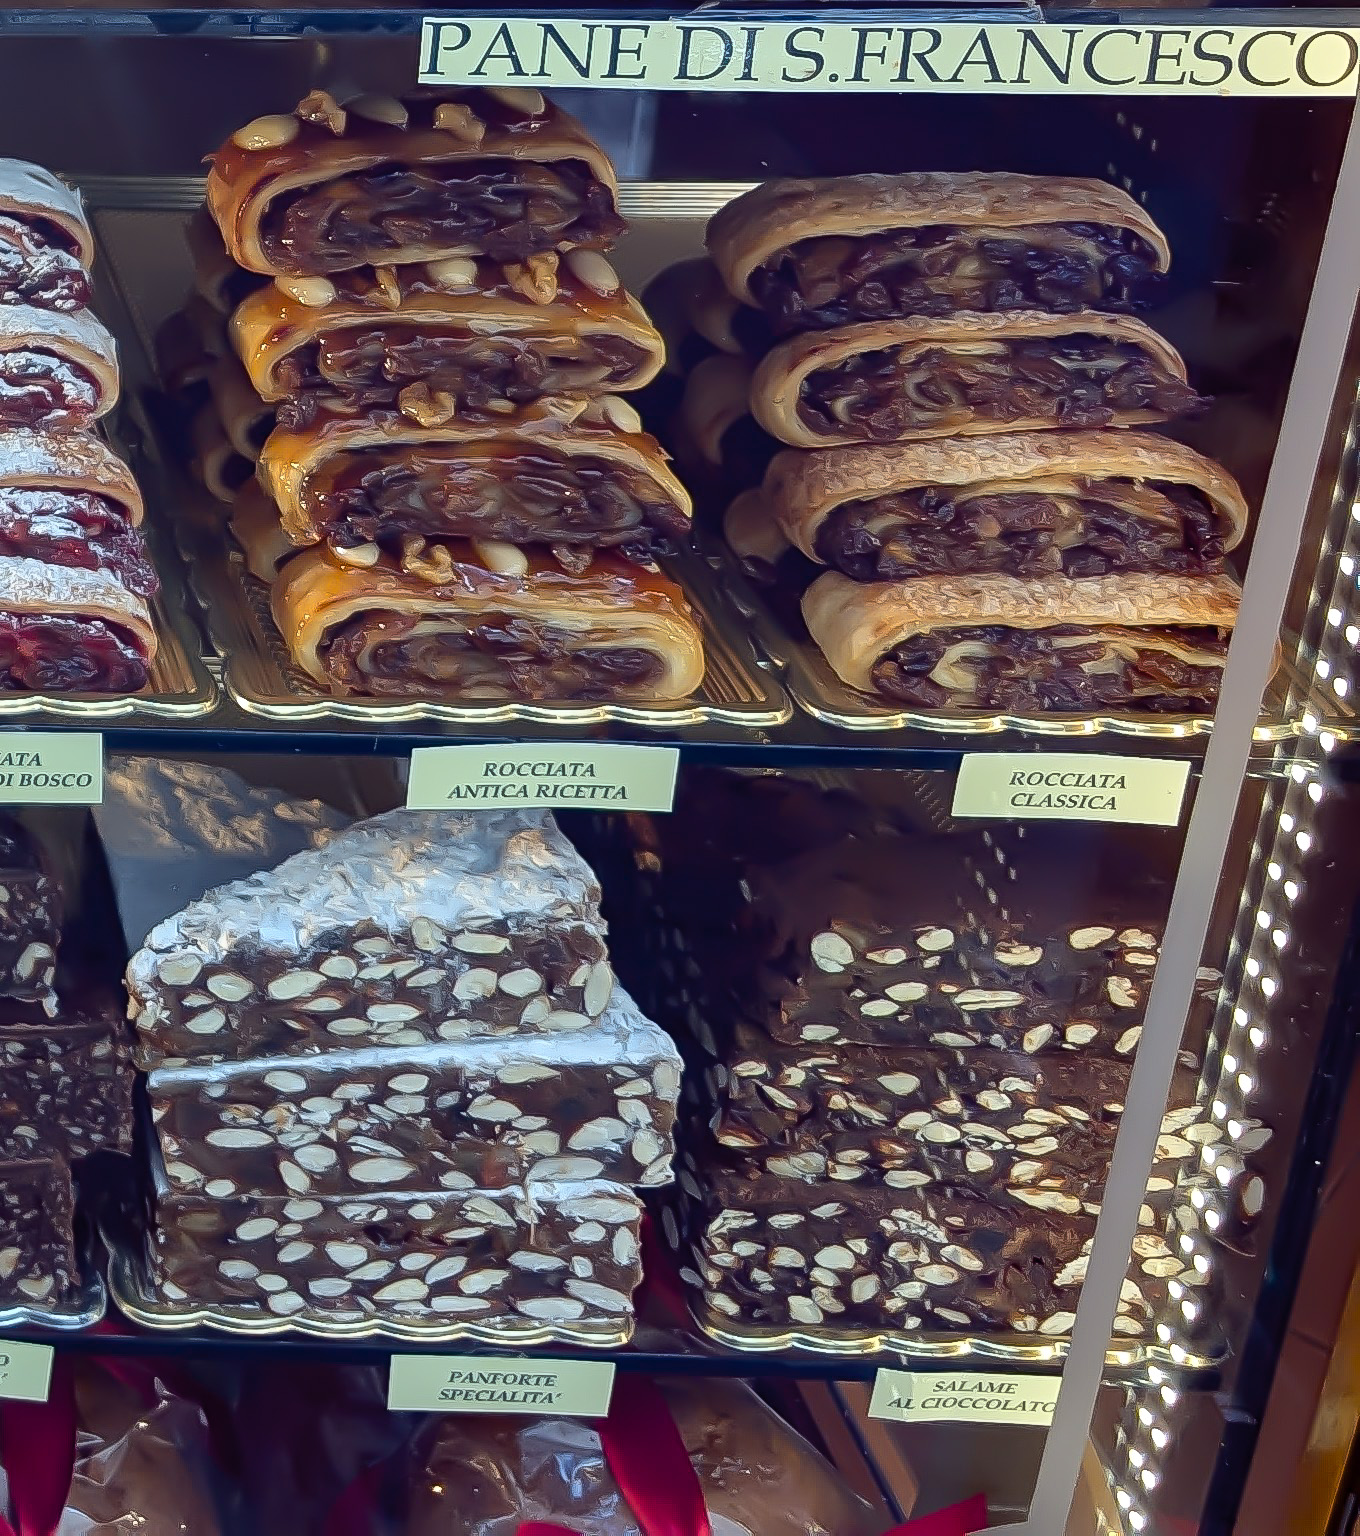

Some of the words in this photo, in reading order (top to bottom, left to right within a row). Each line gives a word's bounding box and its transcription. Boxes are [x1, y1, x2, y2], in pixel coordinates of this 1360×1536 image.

[427, 20, 651, 81] PANE
[673, 24, 766, 83] DI
[780, 24, 1359, 89] S.FRANCESCO
[482, 761, 597, 778] ROCCIATA
[17, 772, 93, 788] BOSCO
[1008, 771, 1127, 790] ROCCIATA
[447, 784, 529, 800] ANTICA
[534, 784, 628, 801] RICETTA
[1009, 791, 1117, 811] CLASSICA
[447, 1369, 559, 1387] PANFORTE
[932, 1379, 1019, 1395] SALAME
[887, 1396, 915, 1410] AL
[920, 1396, 1057, 1413] CIOCCOLATO
